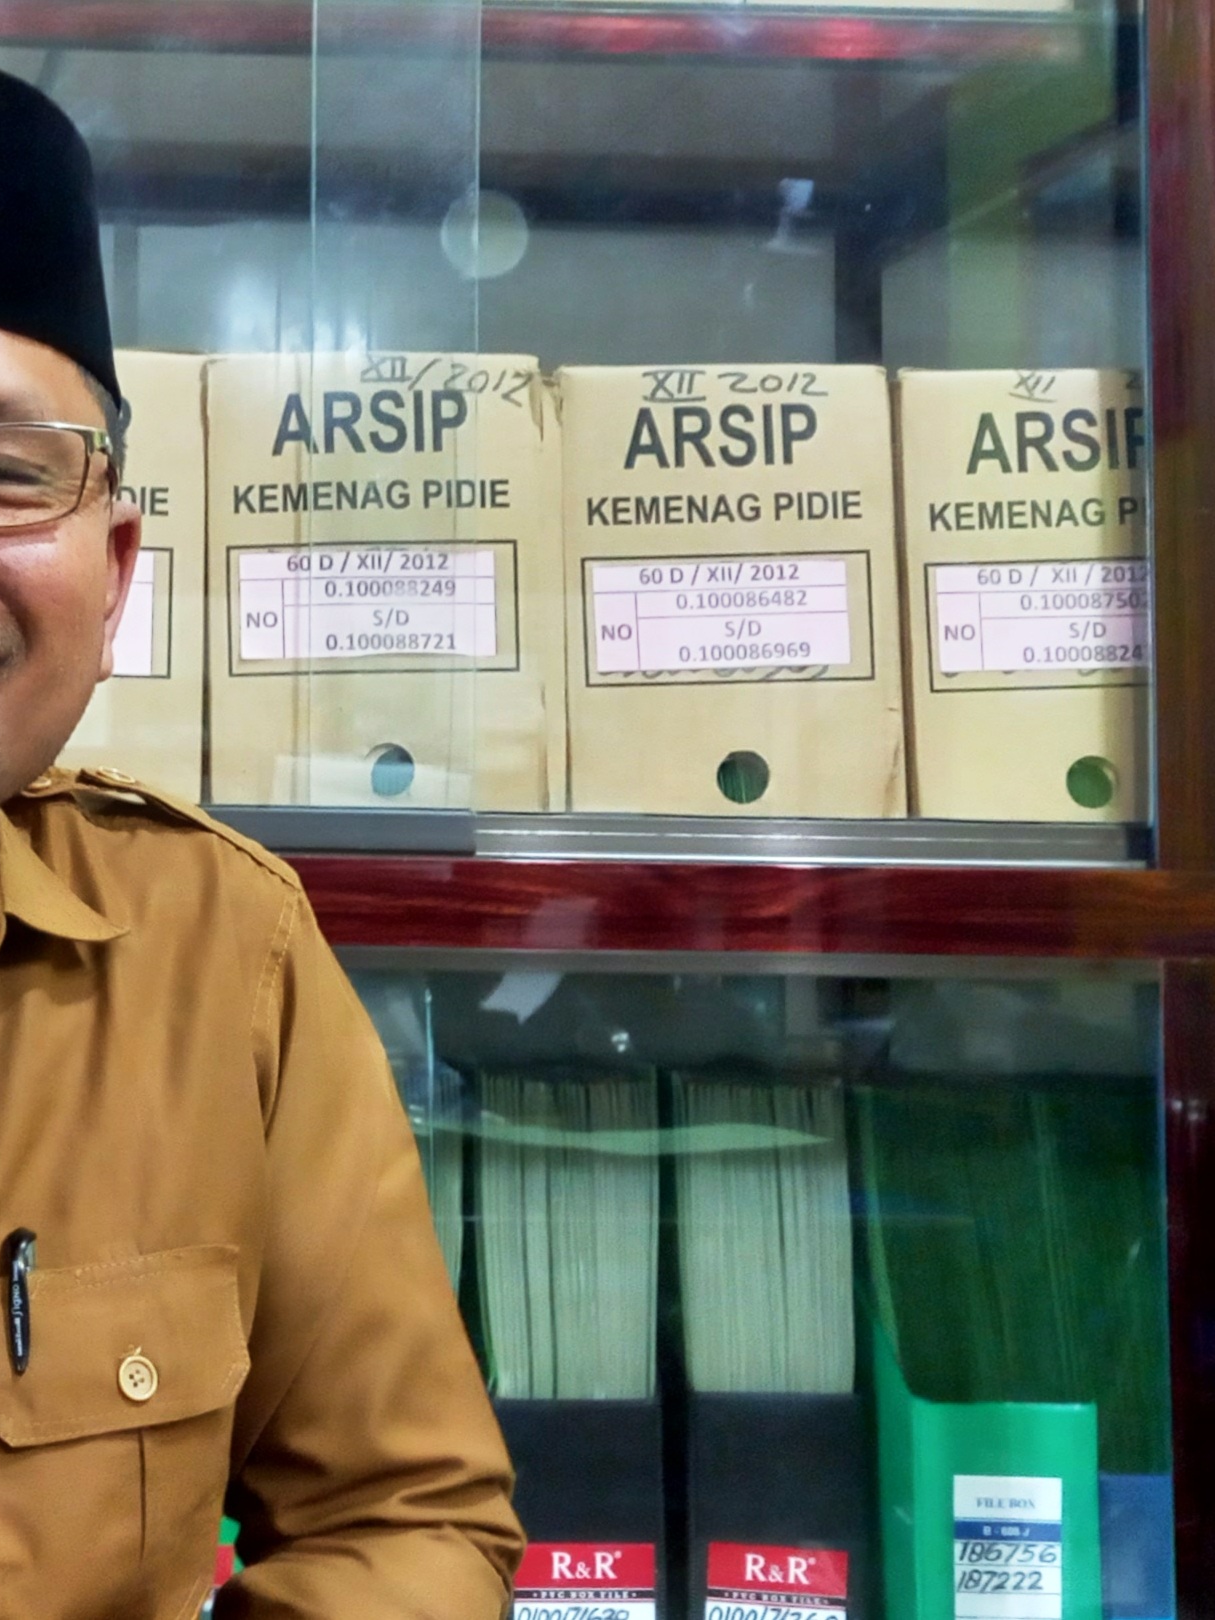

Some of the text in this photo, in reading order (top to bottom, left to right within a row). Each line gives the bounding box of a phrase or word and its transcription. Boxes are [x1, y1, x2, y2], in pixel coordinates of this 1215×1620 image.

[642, 370, 828, 402] XII 2012
[271, 388, 469, 458] ARSIP
[624, 403, 818, 470] ARSIP
[233, 478, 511, 514] KEMENAG PIDIE
[587, 490, 863, 526] KEMENAG PIDIE
[929, 498, 1106, 532] KEMENAG
[287, 554, 311, 572] 60
[319, 554, 333, 571] D
[400, 554, 449, 571] 2012
[640, 567, 663, 585] 60
[671, 567, 684, 584] D
[750, 564, 800, 581] 2012
[977, 568, 1001, 586] 60
[1009, 568, 1022, 584] D
[1052, 567, 1077, 583] XII
[325, 579, 456, 598] 0.100088249
[676, 589, 808, 610] 0.100086482
[246, 611, 278, 629] NO
[373, 609, 410, 629] S/D
[601, 623, 632, 641] NO
[725, 620, 762, 640] S/D
[944, 623, 976, 641] NO
[1069, 621, 1107, 642] S/D
[326, 634, 456, 651] 0.100088721
[679, 641, 811, 663] 0.100086969
[959, 1541, 1057, 1564] 186756
[956, 1569, 1043, 1593] 187222
